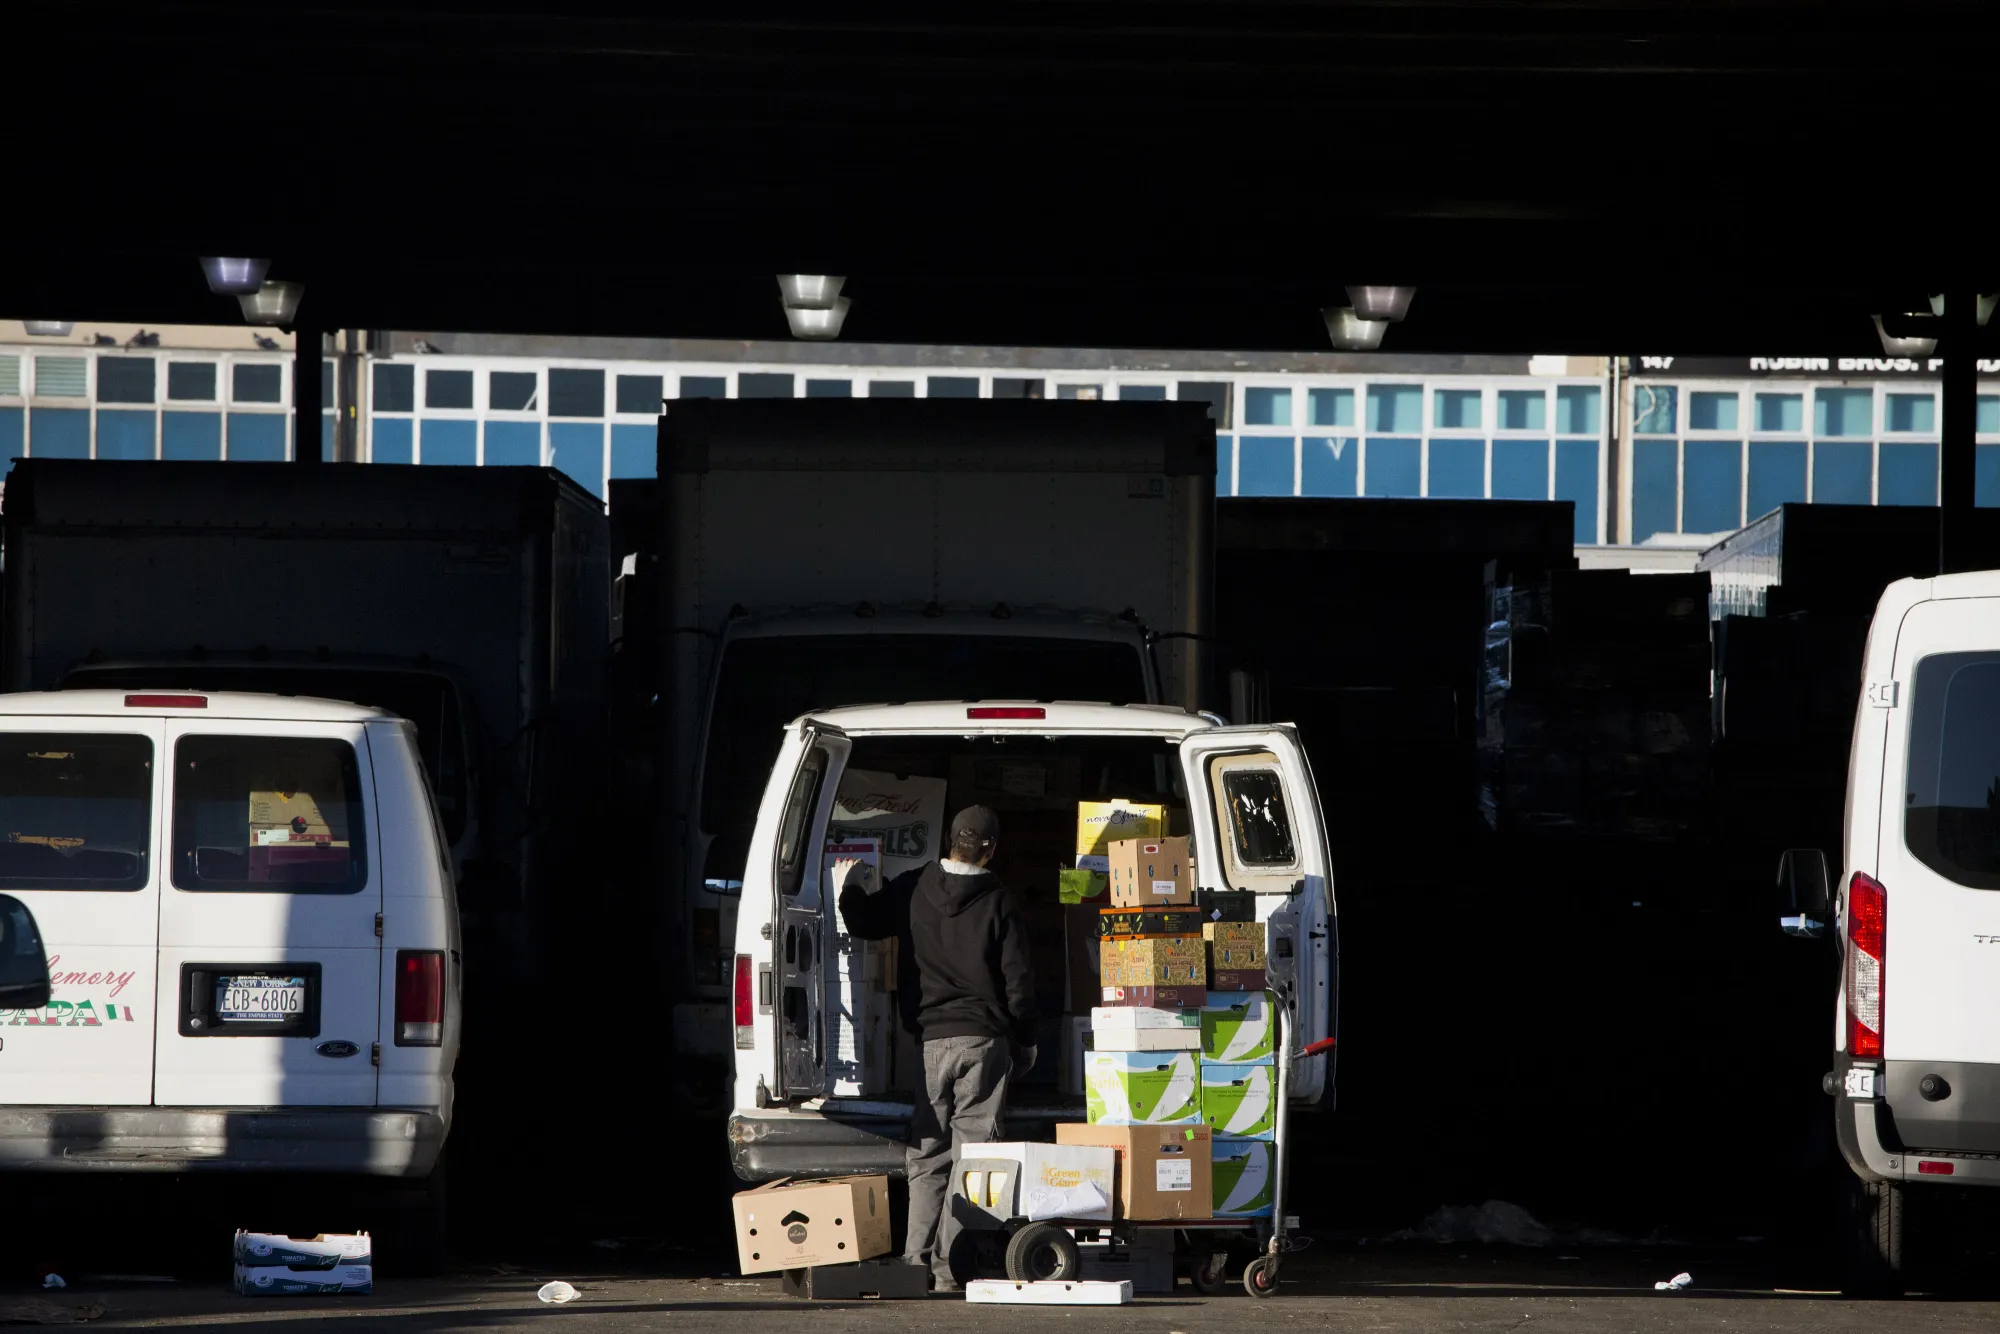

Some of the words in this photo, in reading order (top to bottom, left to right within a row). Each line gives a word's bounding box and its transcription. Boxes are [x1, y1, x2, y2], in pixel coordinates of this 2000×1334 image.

[238, 979, 258, 987] NEW
[260, 979, 285, 987] YORK
[261, 990, 297, 1011] 6806
[327, 1044, 349, 1053] Ford
[1048, 1168, 1080, 1178] Green
